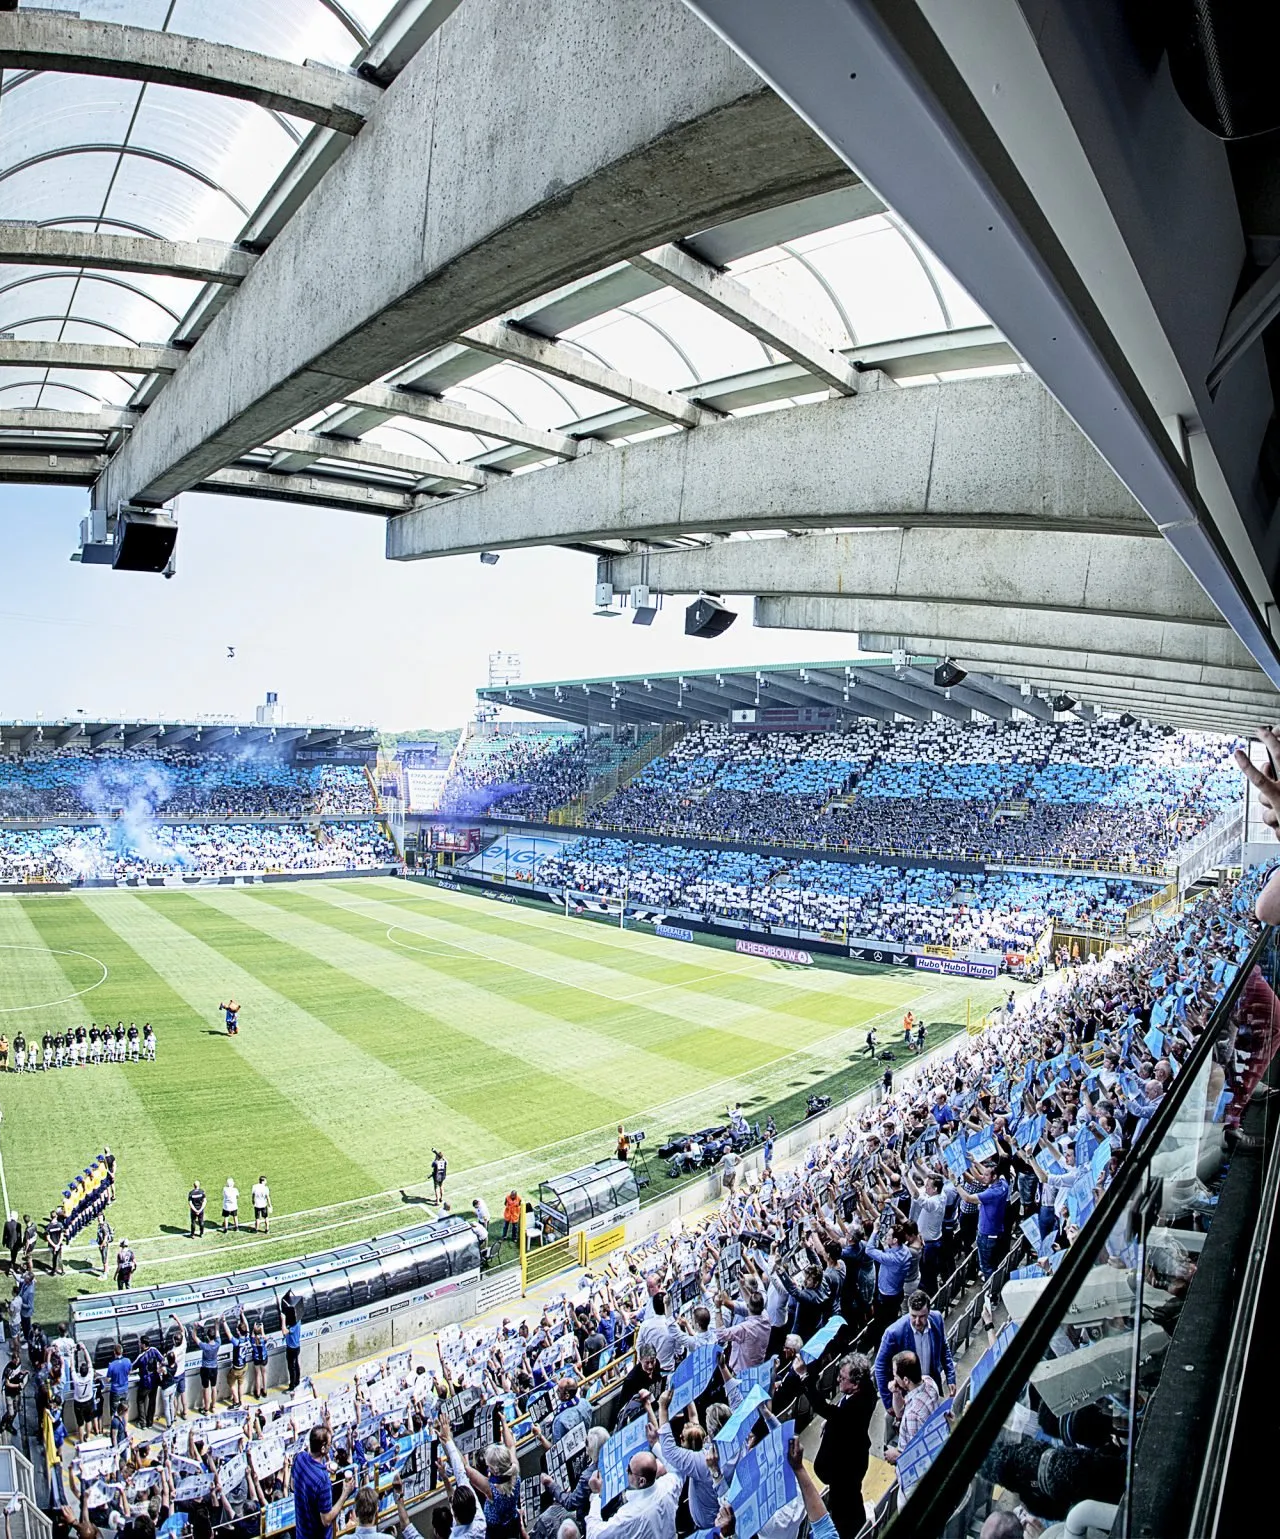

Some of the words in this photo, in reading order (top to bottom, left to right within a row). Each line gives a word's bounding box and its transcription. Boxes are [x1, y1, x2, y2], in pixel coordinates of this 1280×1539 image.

[737, 942, 796, 961] ALHEEMBOUW
[918, 959, 941, 969] Hubo
[943, 963, 966, 972] Hubo
[970, 966, 993, 975] Hubo
[85, 1309, 112, 1317] DAIKIN
[175, 1294, 200, 1302] DAIKIN
[281, 1271, 306, 1280] DAIKIN
[345, 1315, 367, 1325] DAIKIN
